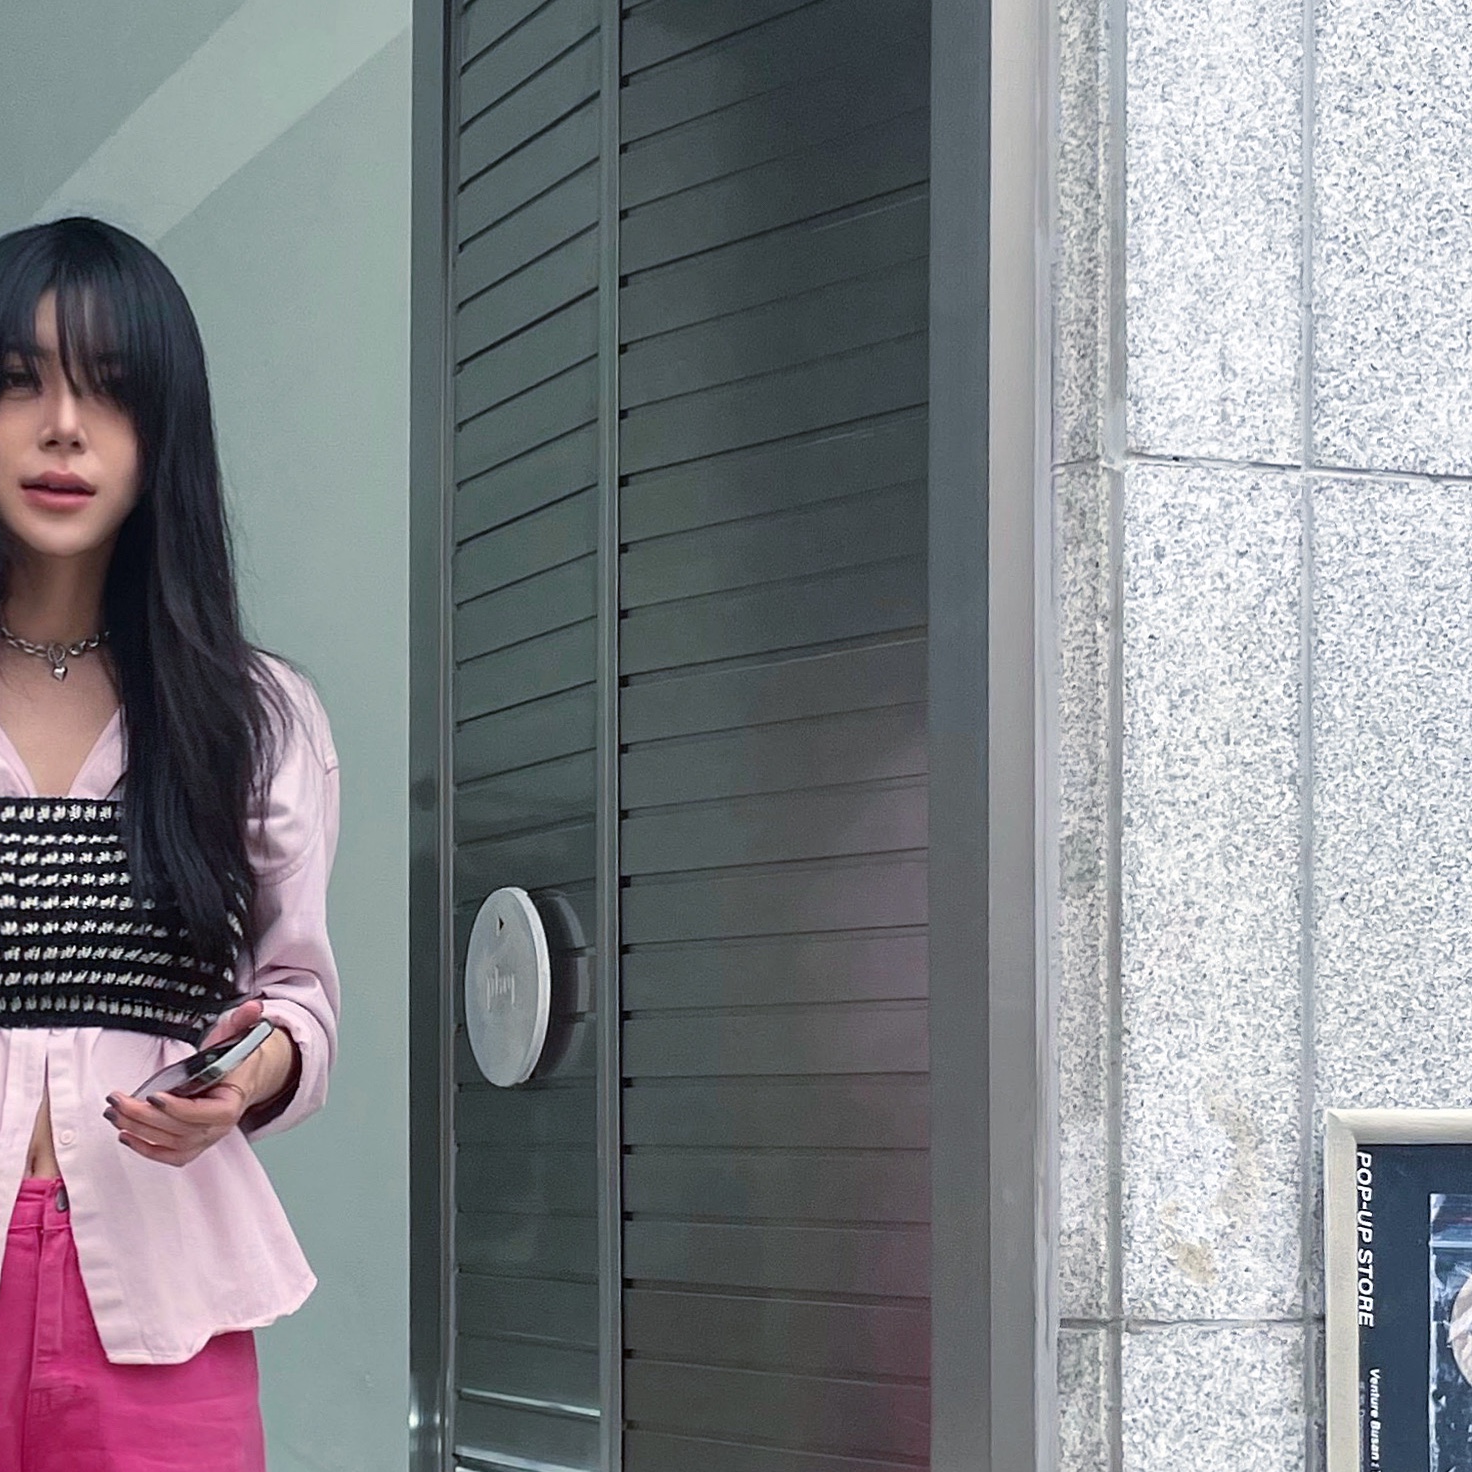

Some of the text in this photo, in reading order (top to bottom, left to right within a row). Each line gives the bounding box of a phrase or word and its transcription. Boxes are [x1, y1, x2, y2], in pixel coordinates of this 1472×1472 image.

[1357, 1152, 1374, 1327] POP-UP STORE
[1369, 1368, 1380, 1418] Venture
[1370, 1420, 1381, 1460] Busan
